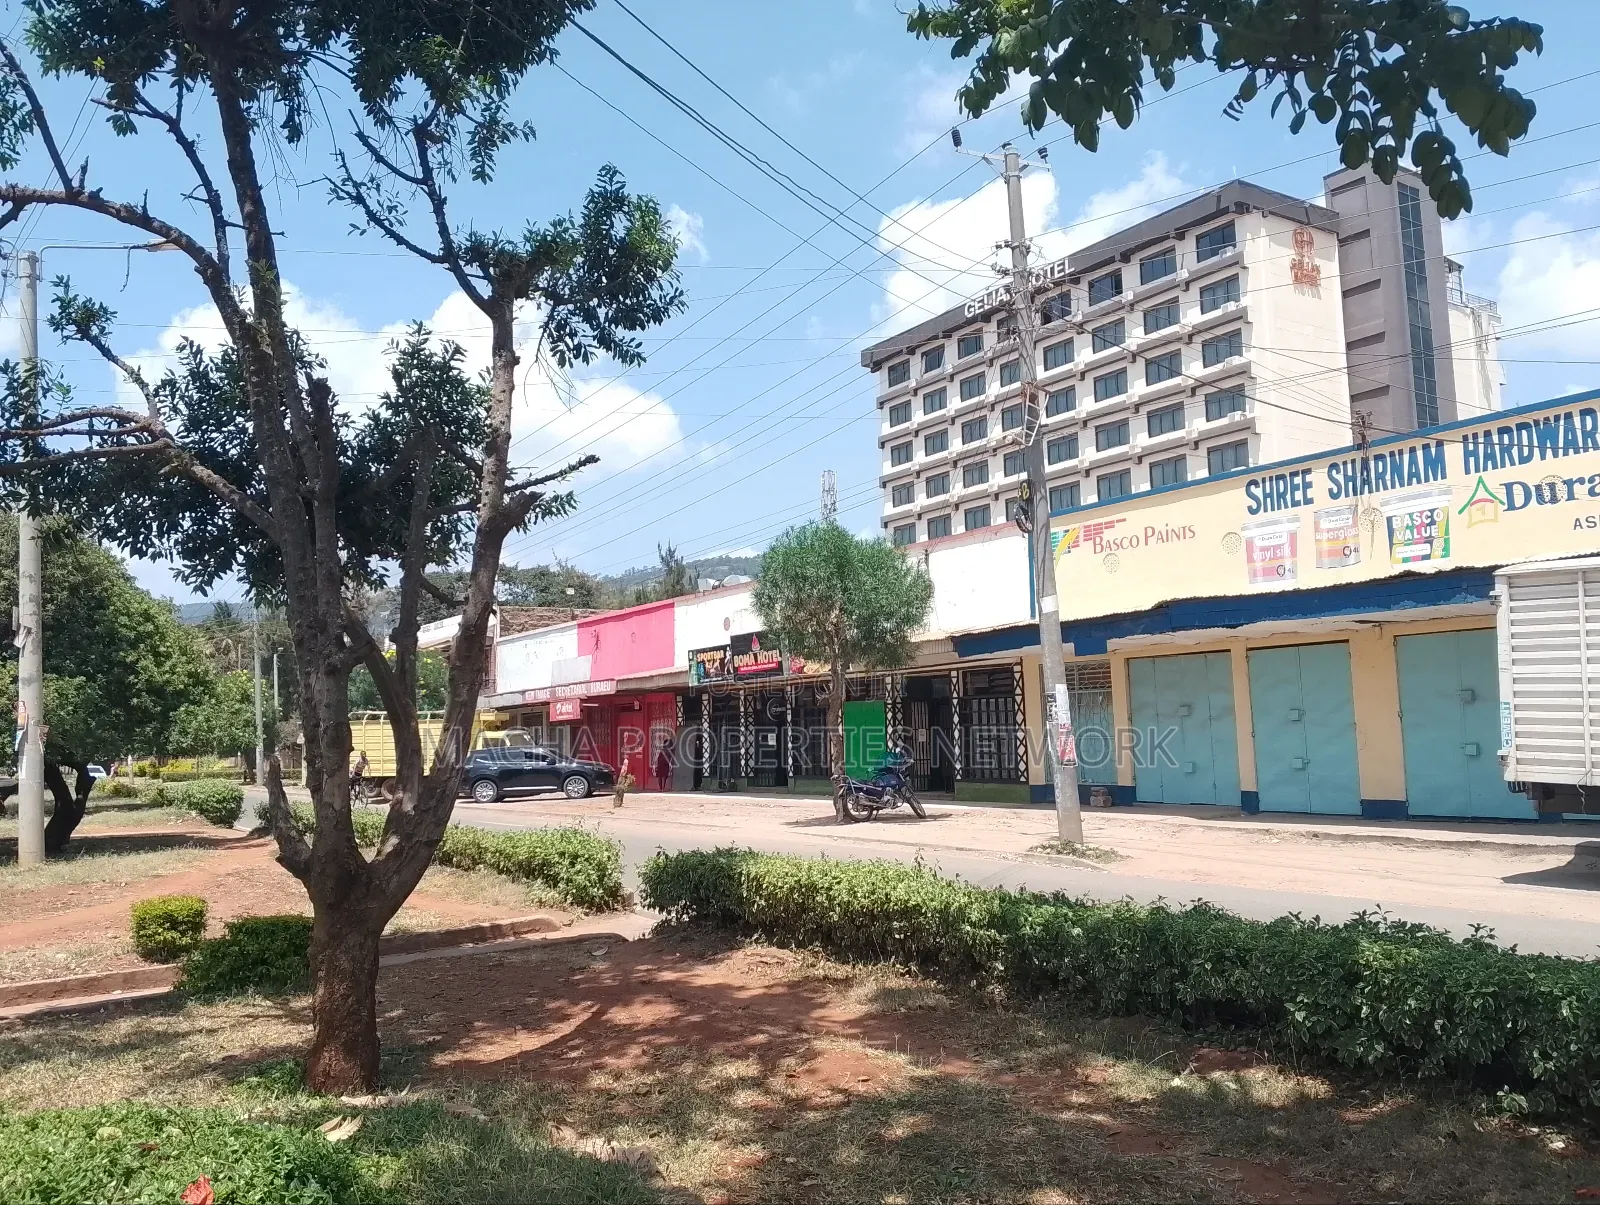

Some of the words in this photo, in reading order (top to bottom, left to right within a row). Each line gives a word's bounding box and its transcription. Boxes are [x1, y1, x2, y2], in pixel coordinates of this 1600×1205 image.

[1245, 467, 1315, 516] SHREE
[1327, 440, 1448, 500] SHARNAM
[1392, 508, 1444, 529] BASCO
[1396, 525, 1439, 541] VALUE
[733, 652, 756, 668] BOMA
[757, 649, 781, 663] HOTEL
[1502, 702, 1512, 747] CEMENT
